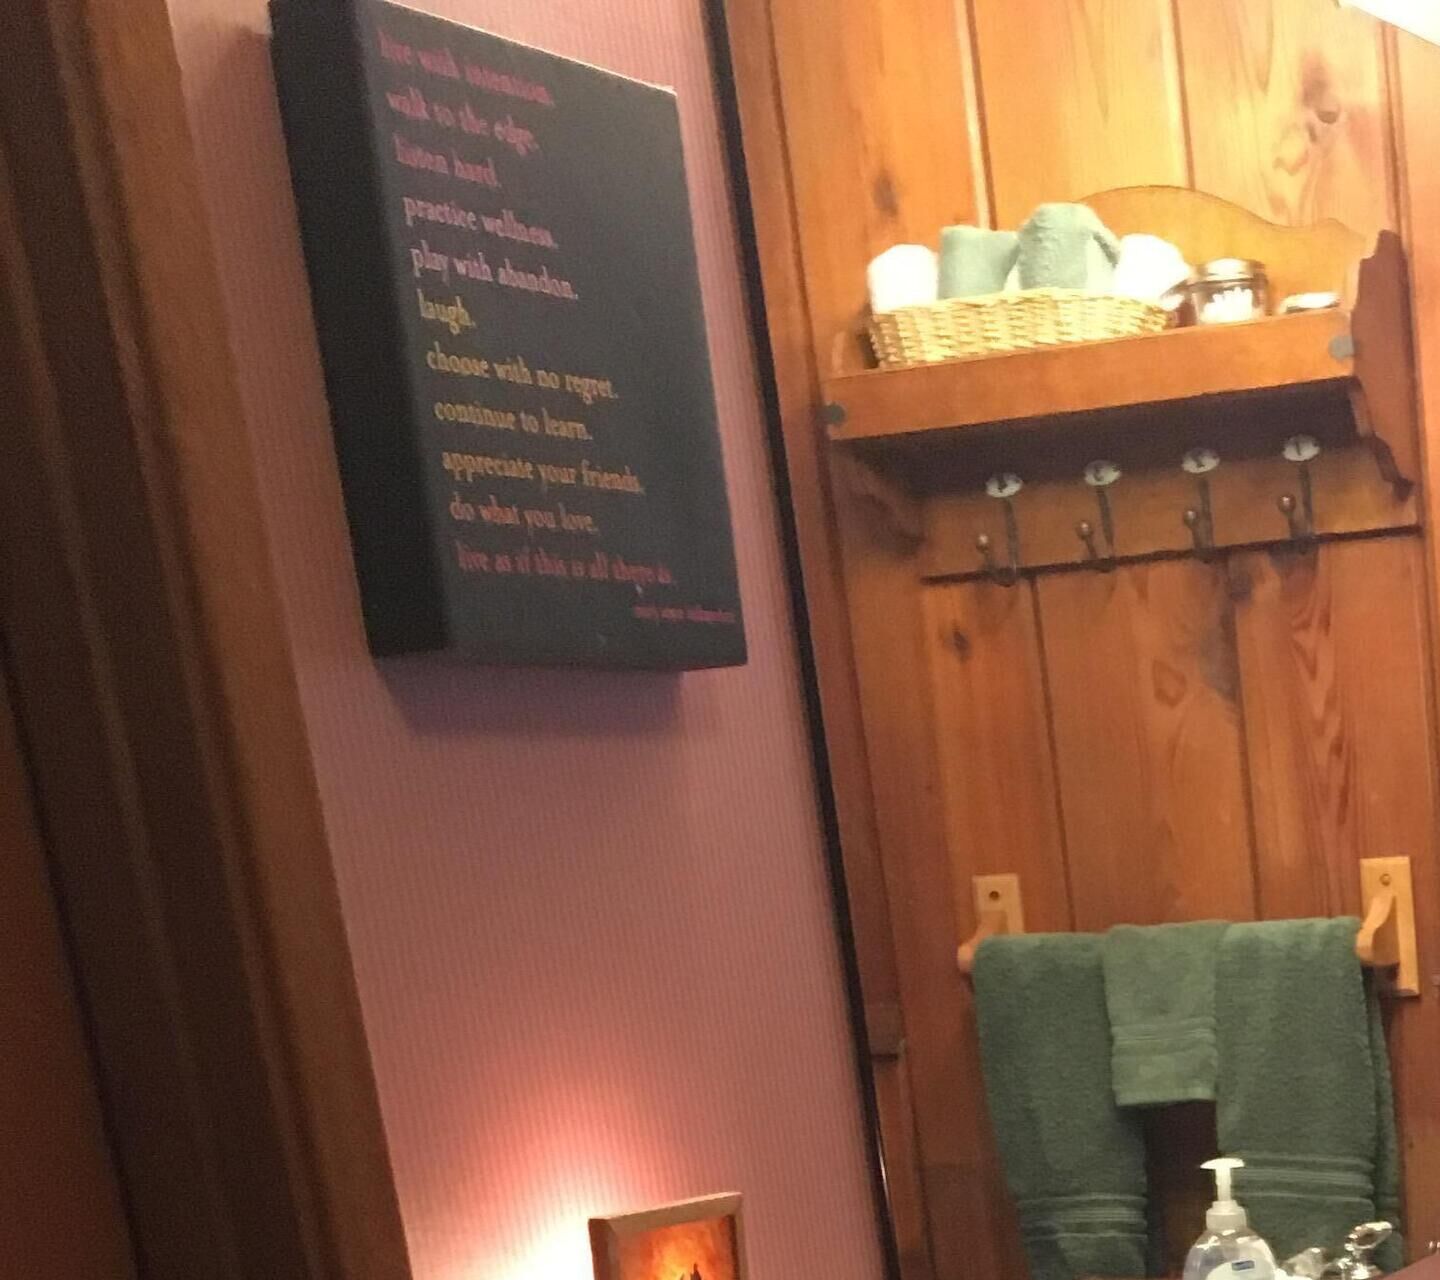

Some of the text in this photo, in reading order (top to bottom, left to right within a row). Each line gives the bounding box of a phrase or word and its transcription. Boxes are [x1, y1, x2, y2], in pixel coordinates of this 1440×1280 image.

[418, 48, 460, 79] with
[386, 85, 431, 120] walk
[433, 103, 456, 127] to
[459, 103, 489, 135] the
[403, 197, 559, 249] practice wellness.
[410, 239, 579, 299] play with abandon.
[416, 288, 476, 335] laugh.
[427, 341, 619, 405] choose with no regret.
[434, 400, 594, 440] continue to learn.
[442, 451, 534, 483] appreciate
[536, 464, 577, 493] your
[450, 491, 475, 521] do
[479, 494, 520, 525] what
[524, 510, 555, 537] you
